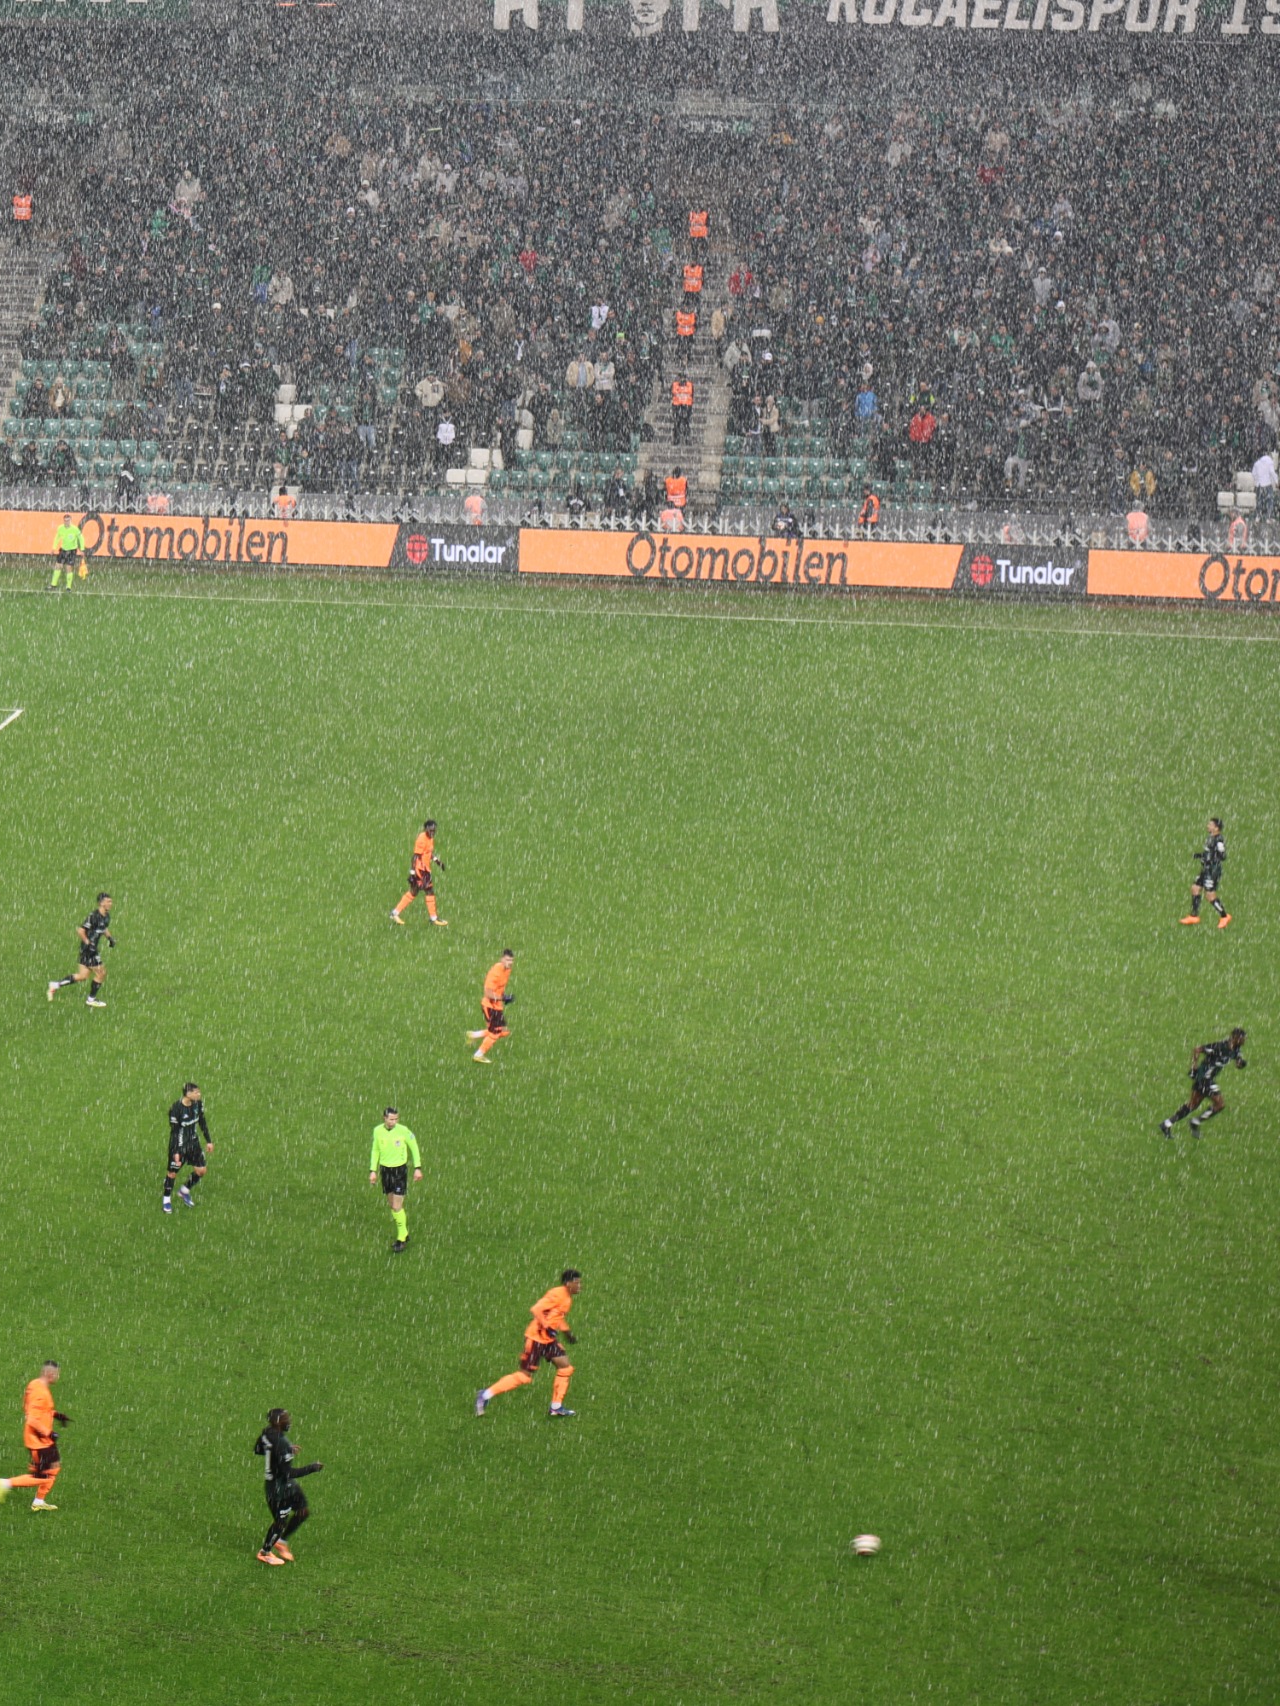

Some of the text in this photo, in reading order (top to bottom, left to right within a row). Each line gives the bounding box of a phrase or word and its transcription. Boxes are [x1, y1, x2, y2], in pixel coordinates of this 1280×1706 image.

[78, 511, 288, 563] Otomobilen
[431, 538, 506, 564] Tunalar
[626, 531, 848, 585] Otomobilen
[996, 560, 1075, 586] Tunalar
[1199, 553, 1280, 603] Oto
